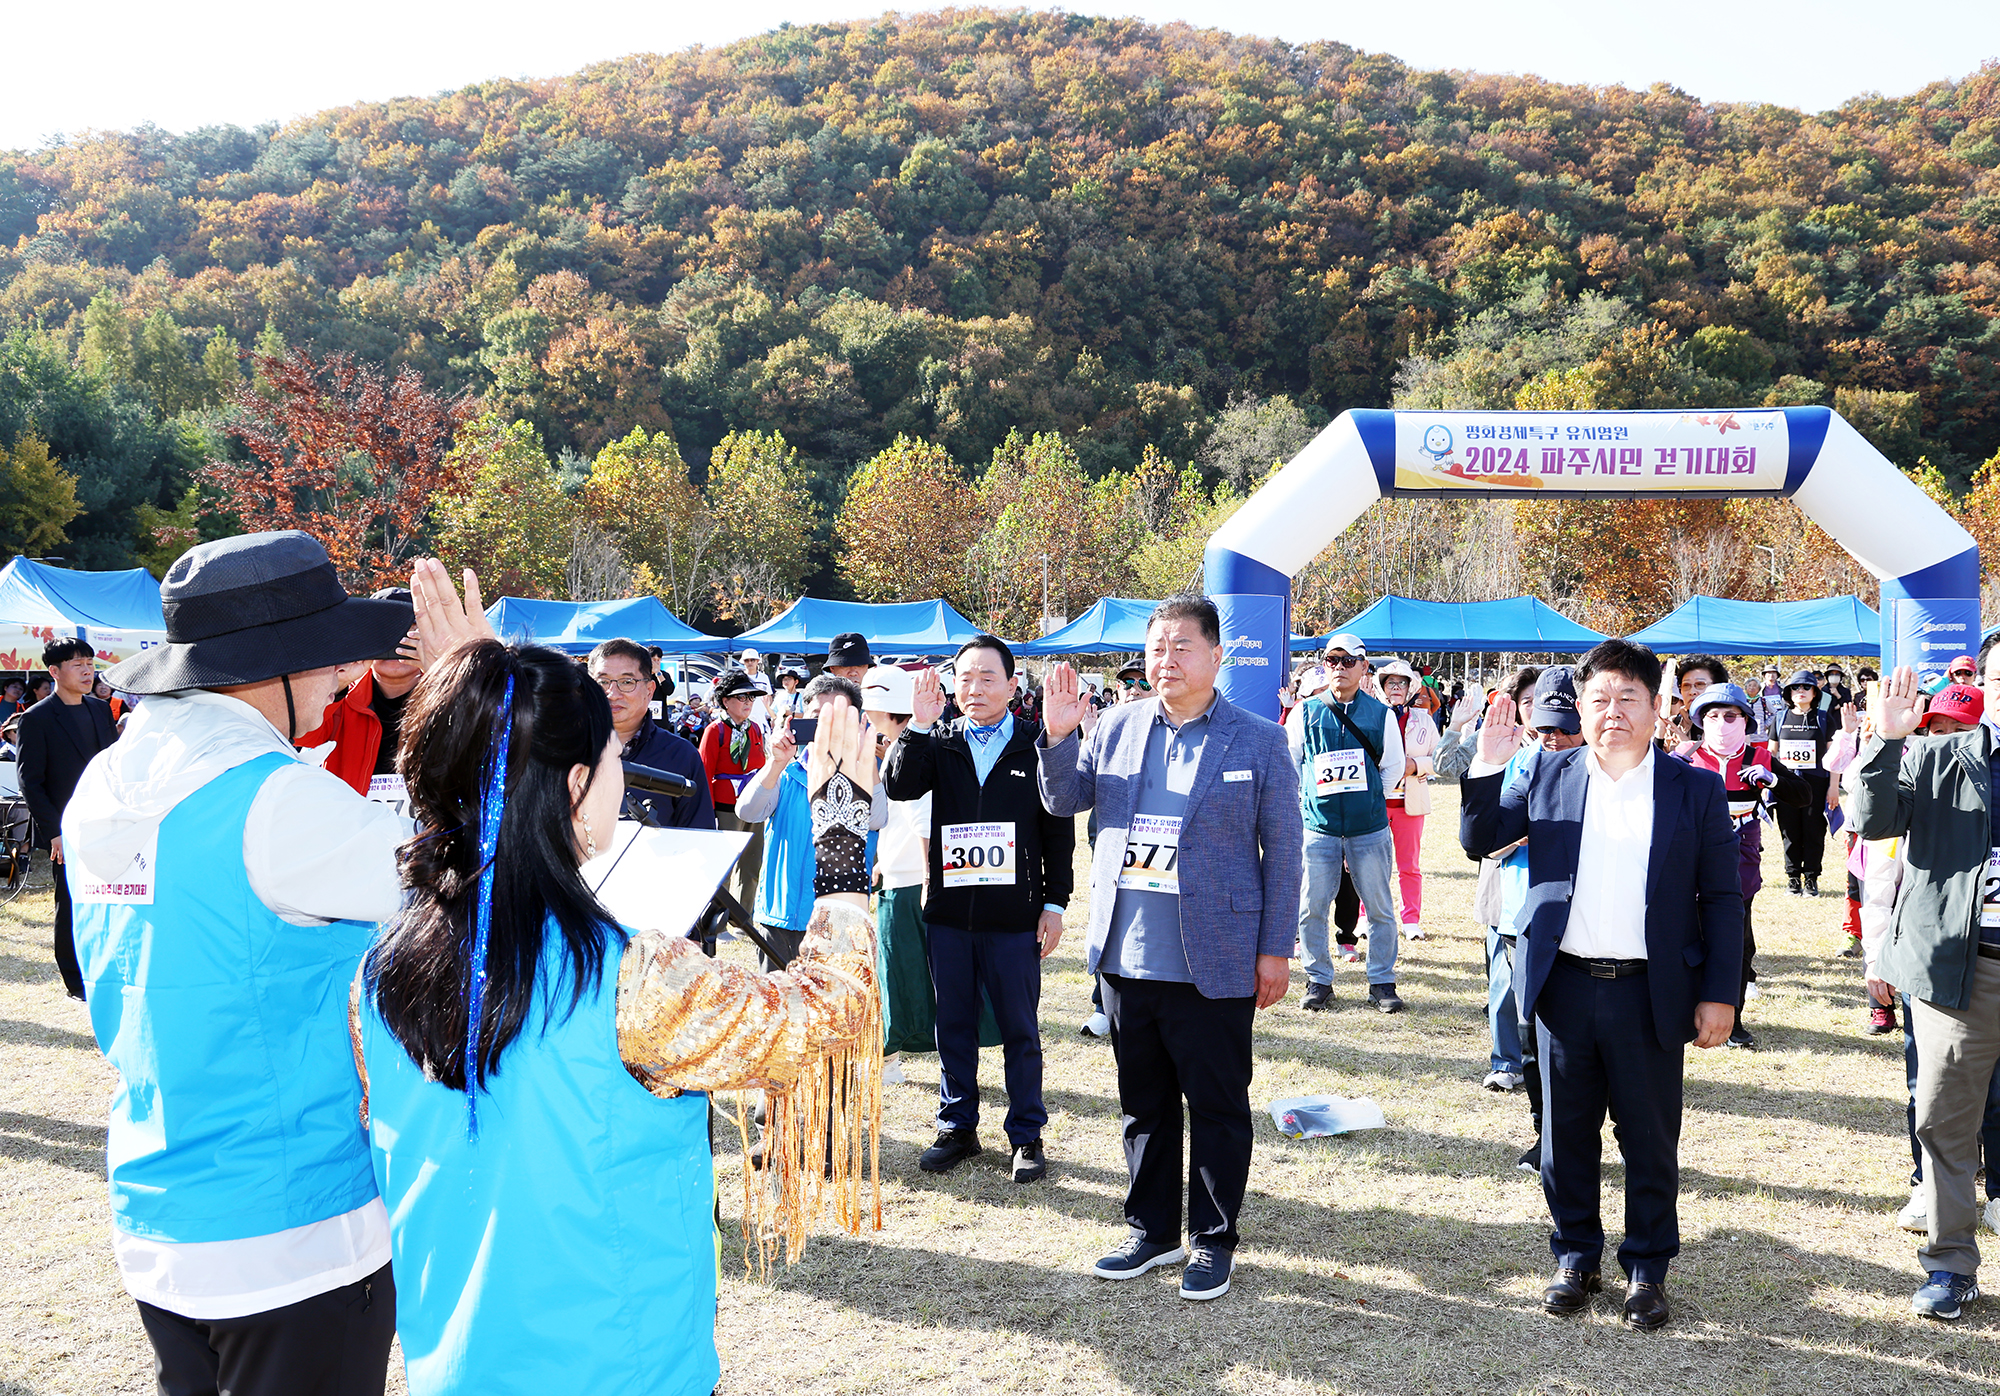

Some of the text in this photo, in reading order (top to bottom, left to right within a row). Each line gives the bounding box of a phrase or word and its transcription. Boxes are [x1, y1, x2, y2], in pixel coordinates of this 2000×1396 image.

[1465, 425, 1629, 440] 평화경제특구 유치염원
[1465, 445, 1756, 475] 2024 파주시민 걷기대회
[1787, 750, 1811, 761] 189
[1010, 769, 1026, 777] FILA
[1322, 764, 1360, 783] 372
[951, 845, 1005, 869] 300
[1123, 842, 1178, 871] 577
[85, 884, 148, 896] 2024 파주시민 걷기대회
